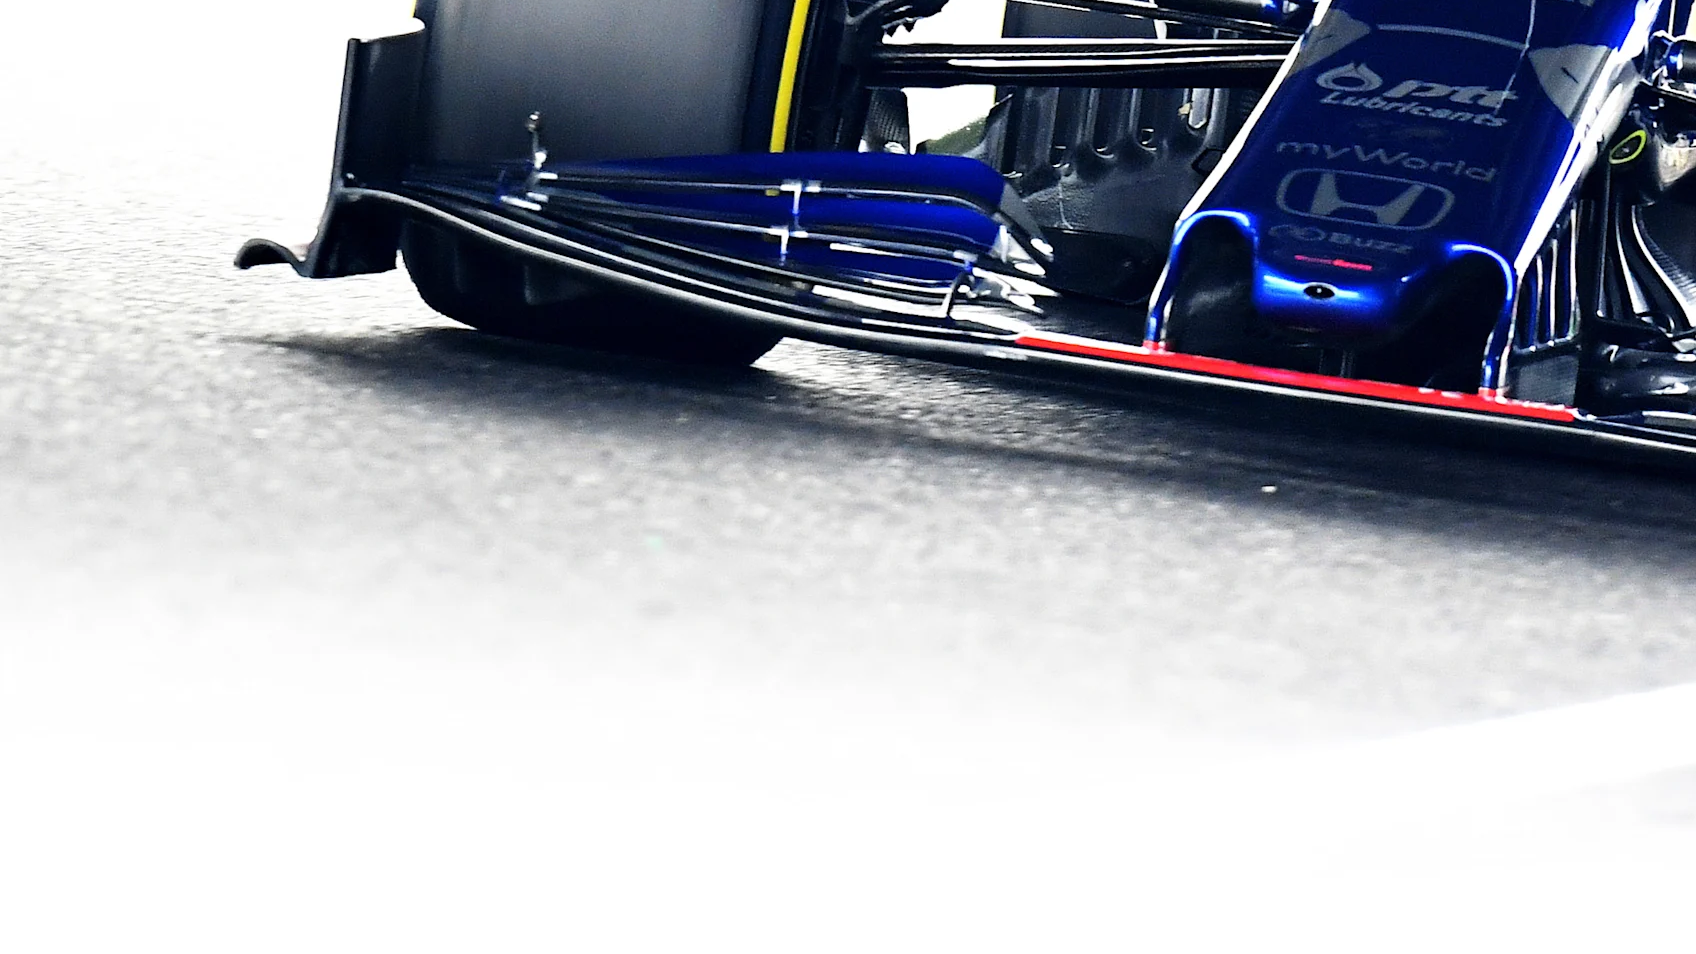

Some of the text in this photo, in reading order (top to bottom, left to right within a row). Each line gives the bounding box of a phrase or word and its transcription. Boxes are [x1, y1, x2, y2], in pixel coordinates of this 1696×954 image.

[1319, 91, 1508, 127] Lubricants
[1382, 79, 1519, 108] ptt
[1275, 142, 1498, 184] myWorld
